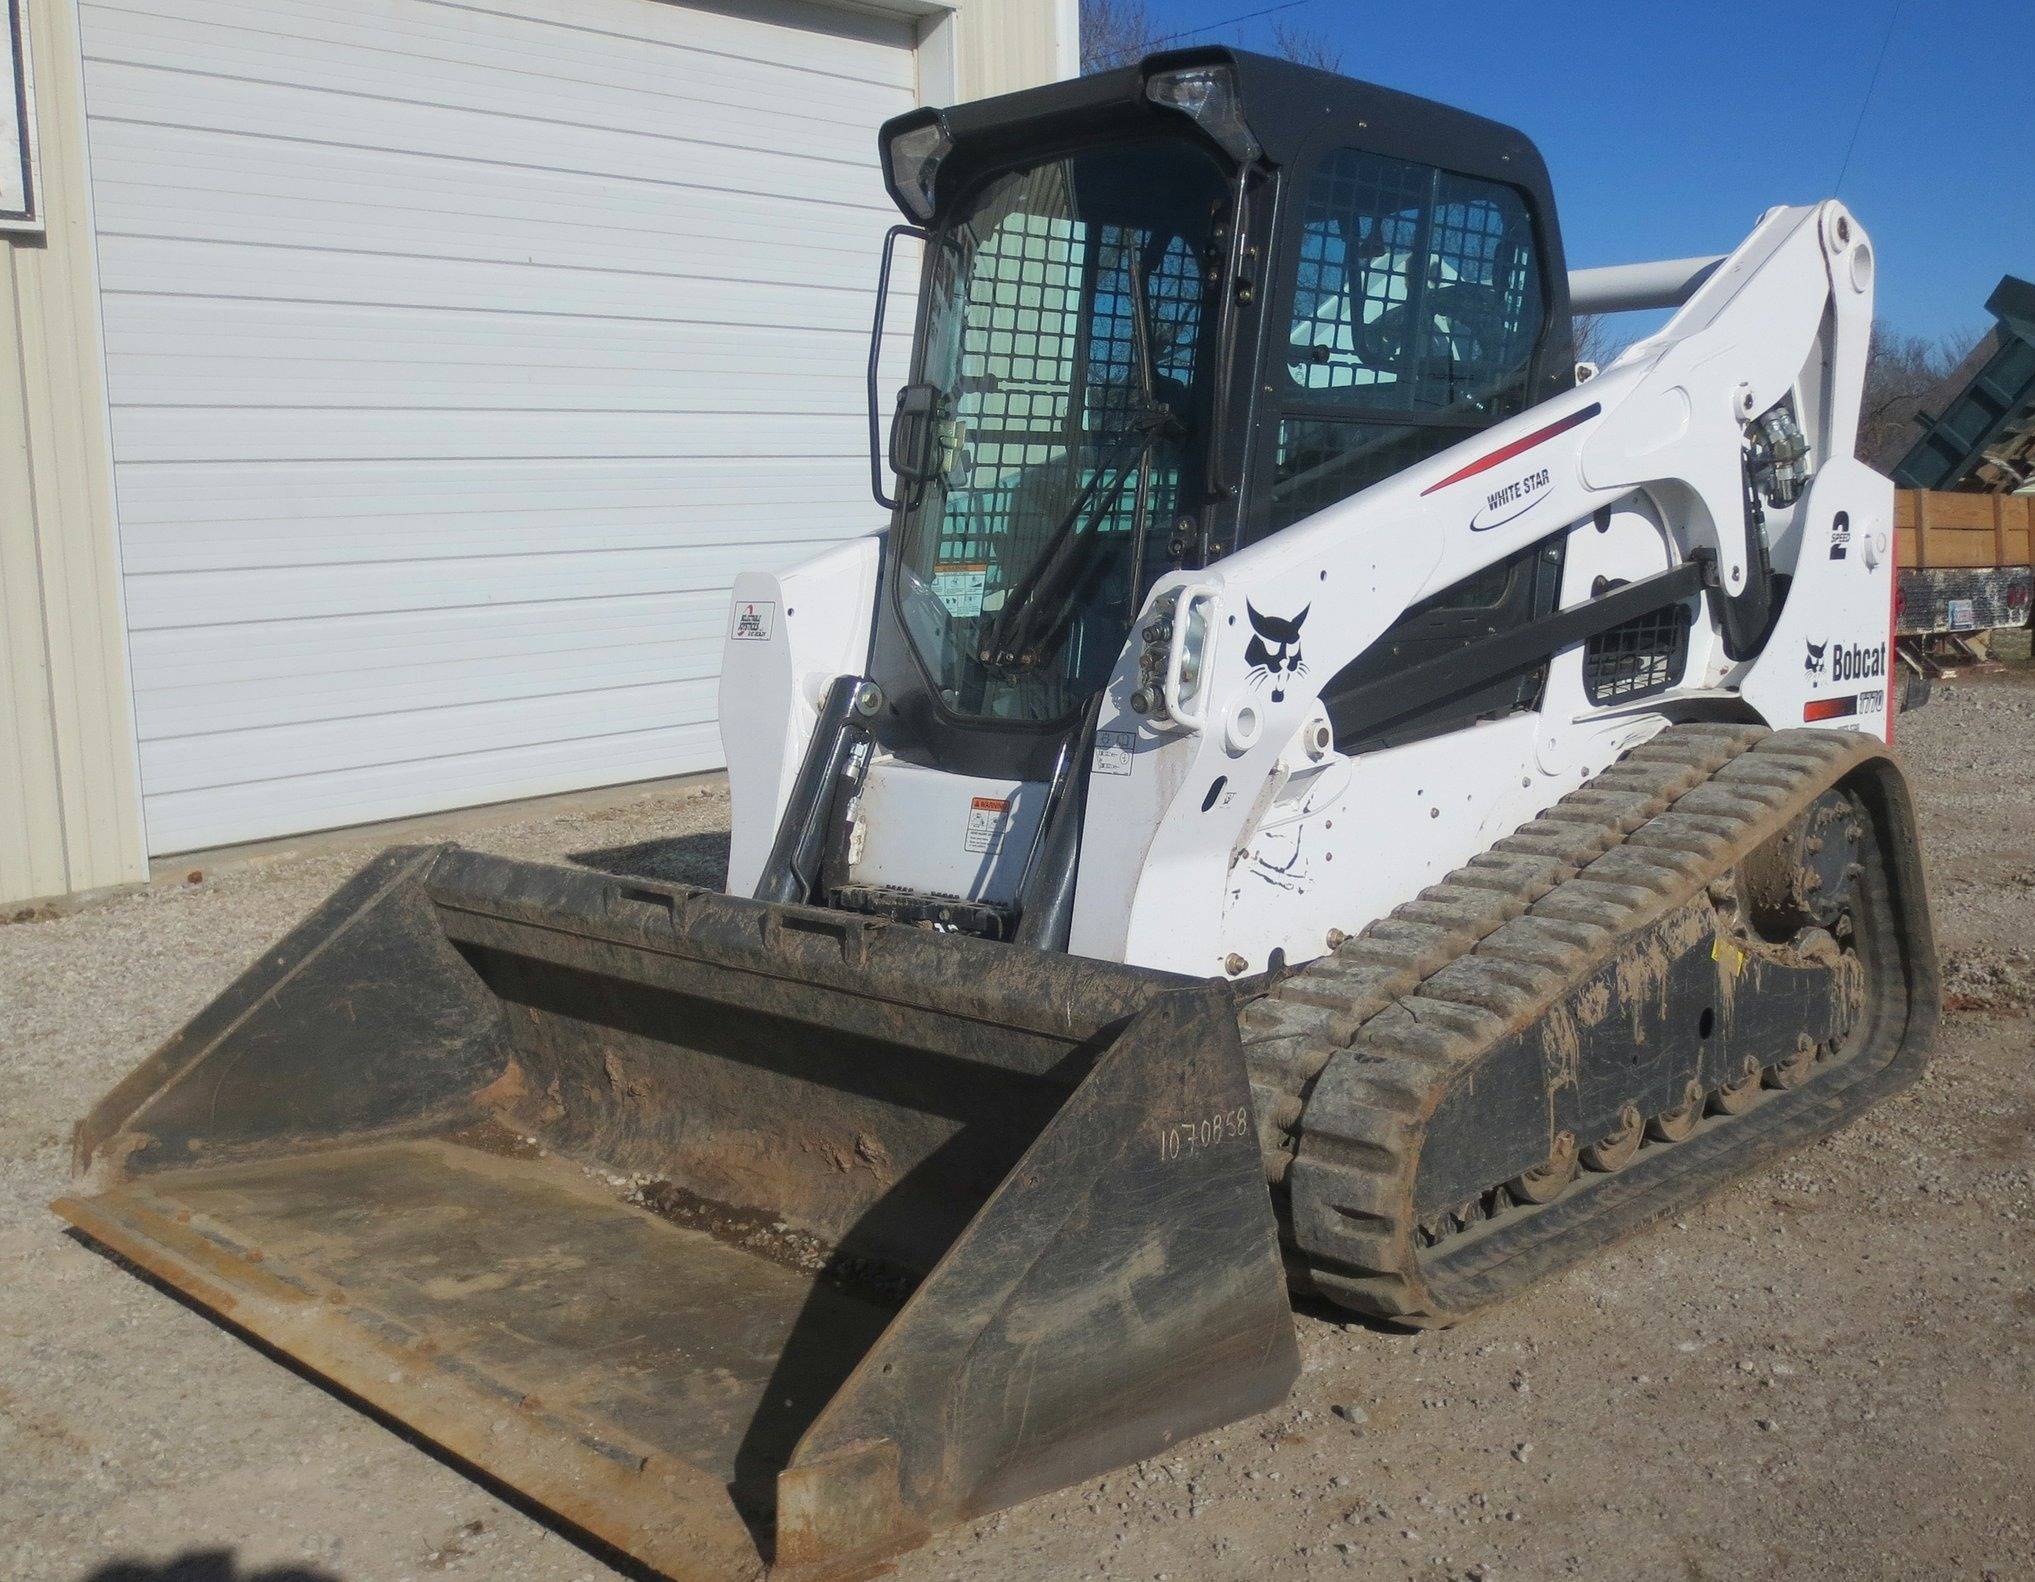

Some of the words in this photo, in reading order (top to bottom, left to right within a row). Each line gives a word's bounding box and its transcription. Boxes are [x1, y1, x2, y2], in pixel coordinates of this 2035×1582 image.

[1487, 482, 1522, 511] WHITE
[1523, 469, 1550, 494] STAR
[1830, 511, 1850, 560] 2
[1831, 532, 1851, 543] SPEED
[1832, 641, 1885, 681] Bobcat
[1859, 690, 1884, 714] T770
[1161, 1106, 1247, 1160] 1070858
